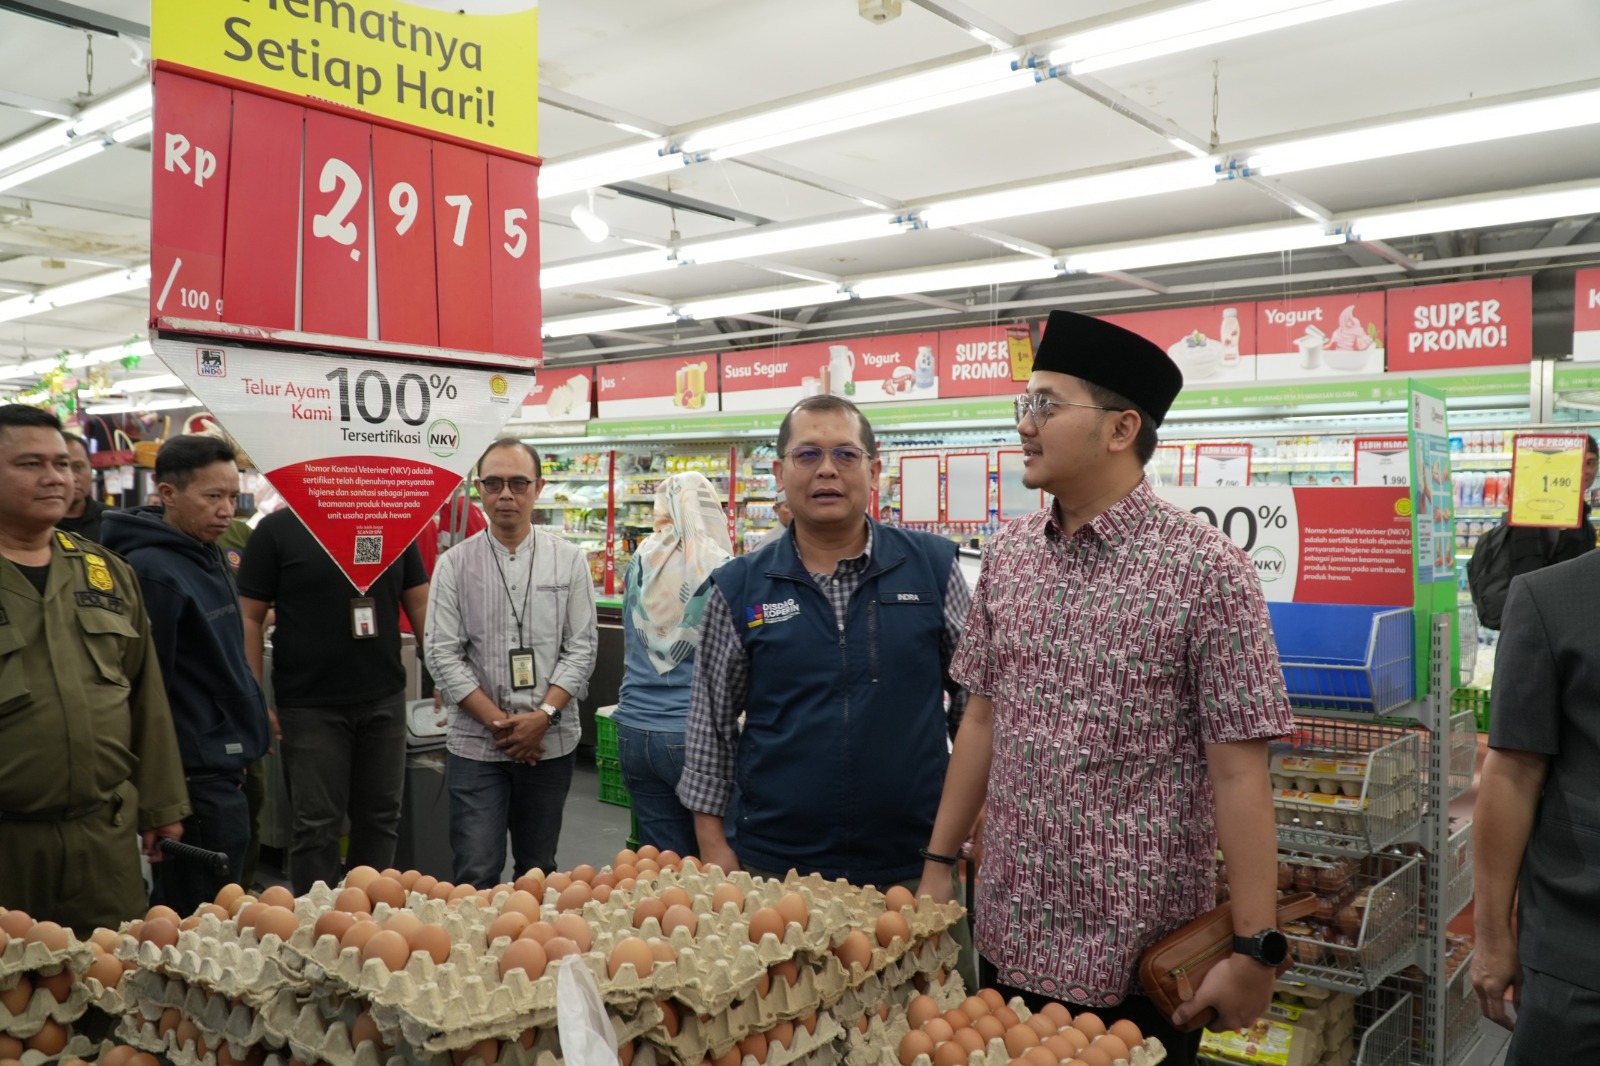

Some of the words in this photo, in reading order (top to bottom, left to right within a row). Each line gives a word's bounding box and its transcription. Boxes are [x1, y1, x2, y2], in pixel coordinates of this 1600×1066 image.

[243, 0, 482, 71] ematnya
[223, 16, 382, 105] Setiap
[396, 64, 496, 128] Hari!
[164, 132, 217, 187] Rp
[1264, 306, 1323, 327] Yogurt
[1413, 299, 1501, 330] SUPER
[1408, 324, 1507, 353] PROMO!
[955, 341, 1009, 363] SUPER
[861, 351, 901, 368] Yogurt
[724, 365, 752, 379] Susu
[754, 361, 789, 377] Segar
[952, 361, 1011, 381] PROMO
[241, 378, 281, 396] Telur
[284, 382, 331, 402] Ayam
[601, 376, 616, 391] Jus
[292, 404, 332, 421] Kami
[340, 427, 421, 444] Tersertifikasi
[430, 433, 457, 447] NKV
[1383, 440, 1408, 449] HEMA
[305, 464, 330, 473] Nomor
[331, 464, 357, 473] Kontrol
[358, 466, 389, 474] Veteriner
[390, 467, 411, 476] (NKV)
[411, 467, 433, 475] adalah
[303, 476, 335, 484] sertifikat
[336, 477, 354, 485] telah
[355, 477, 395, 486] dipenuhinya
[396, 479, 434, 487] persyaratan
[1382, 475, 1407, 485] 1.990
[1543, 475, 1572, 493] 1.490
[308, 487, 335, 497] higiene
[336, 488, 349, 496] dan
[350, 489, 376, 497] sanitasi
[377, 489, 402, 498] sebagai
[403, 489, 429, 498] jaminan
[318, 499, 355, 508] keamanan
[356, 500, 380, 509] produk
[381, 500, 403, 508] hewan
[404, 501, 420, 509] pada
[327, 511, 342, 519] unit
[343, 511, 363, 519] usaha
[364, 512, 388, 520] produk
[1387, 528, 1410, 536] (NKV)
[1328, 536, 1358, 544] sertifikat
[1345, 546, 1370, 555] higiene
[1254, 560, 1282, 571] NKV
[1304, 555, 1329, 563] sebagai
[1303, 573, 1327, 581] produk
[897, 593, 920, 601] INDRA
[762, 598, 795, 611] DISDAG
